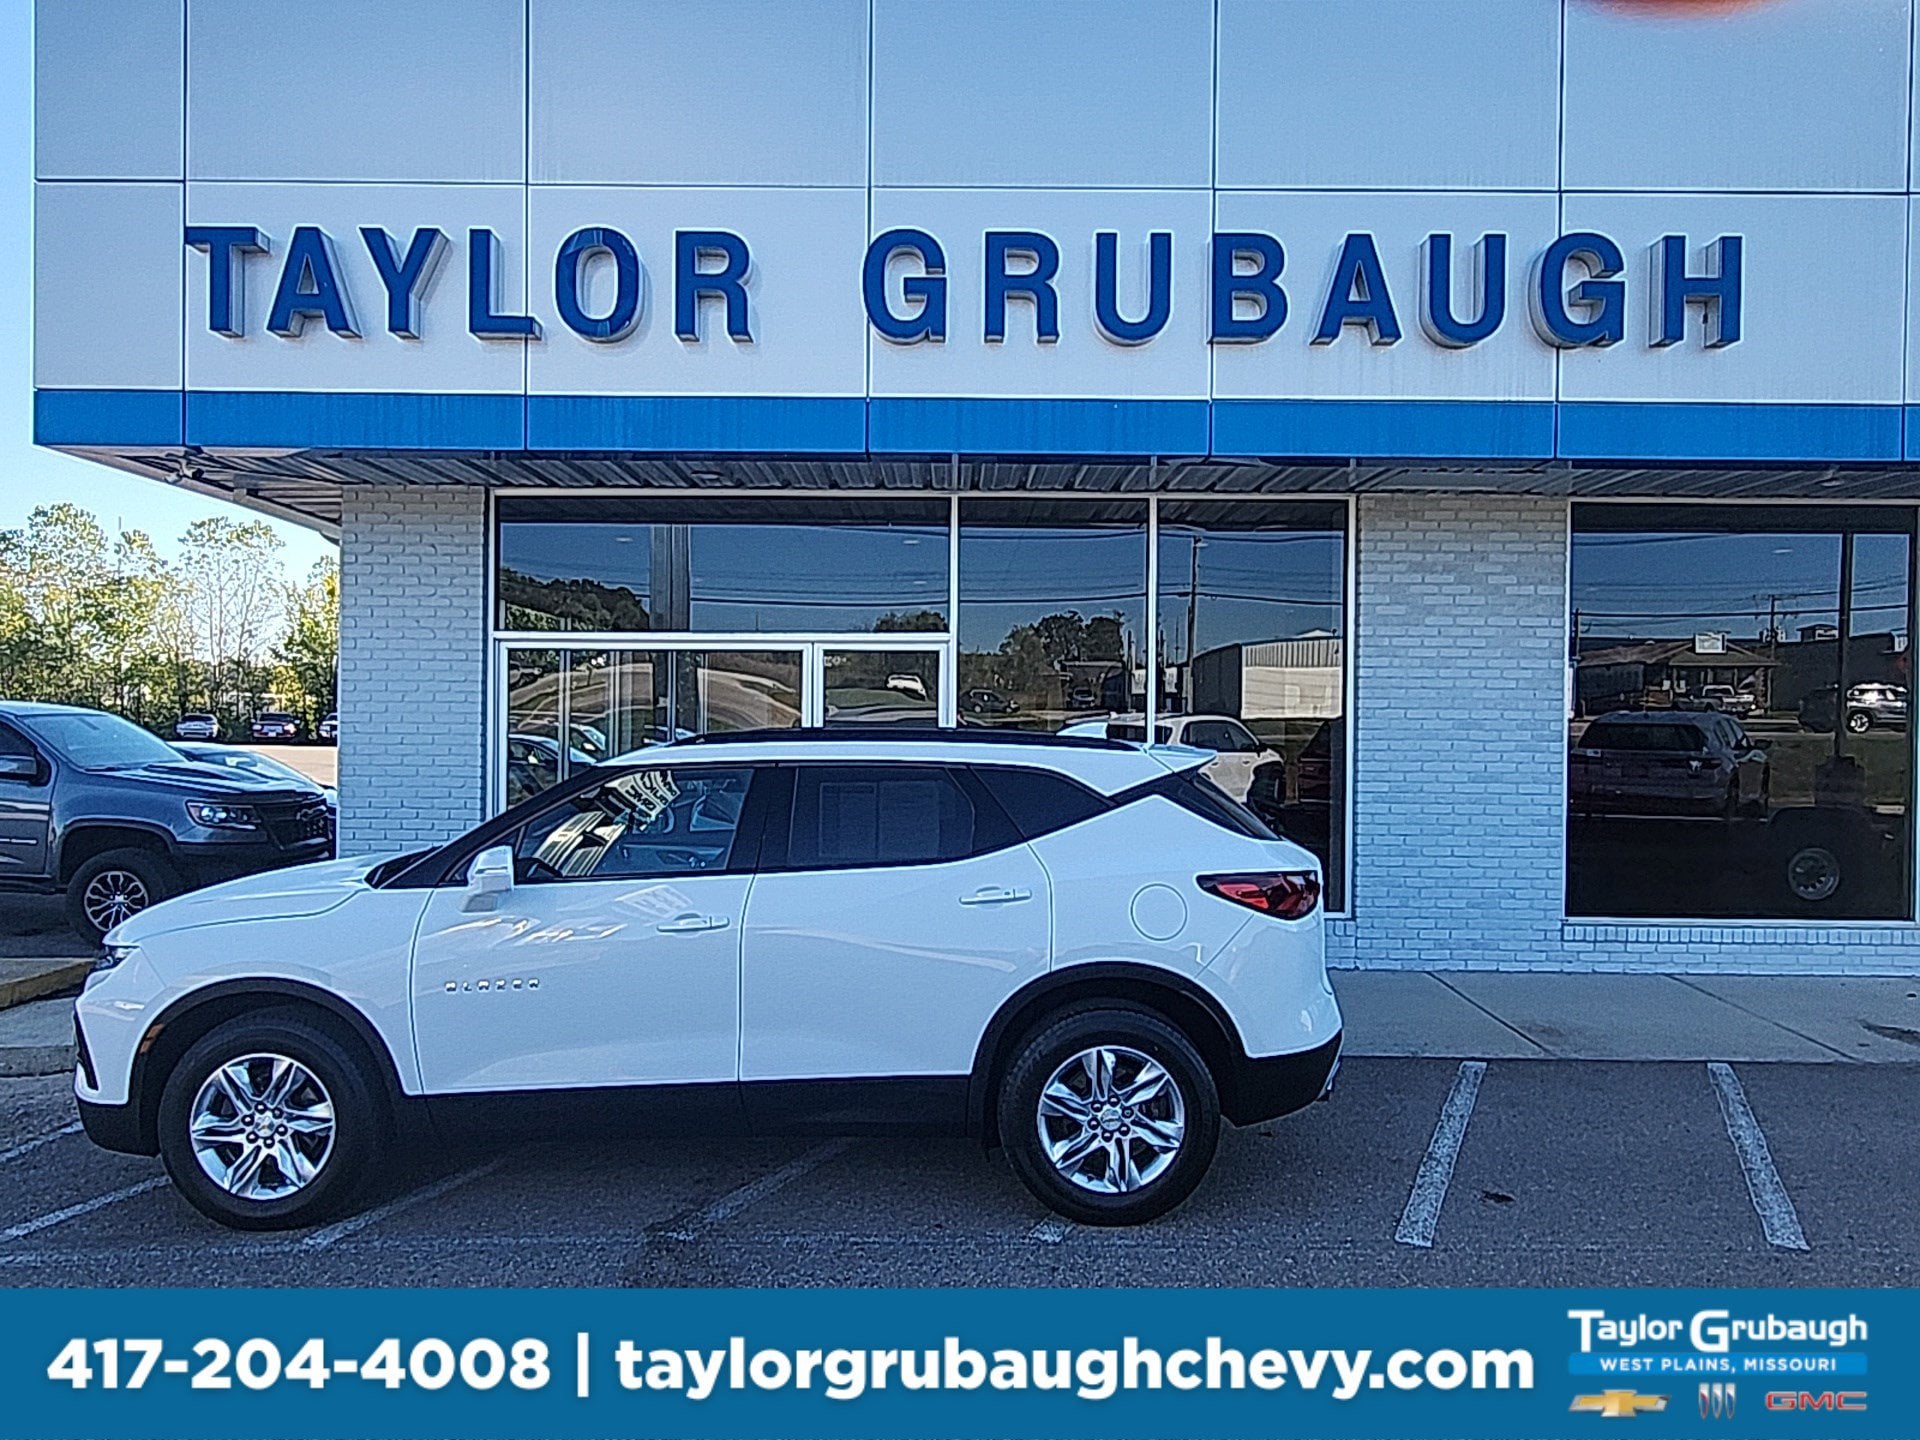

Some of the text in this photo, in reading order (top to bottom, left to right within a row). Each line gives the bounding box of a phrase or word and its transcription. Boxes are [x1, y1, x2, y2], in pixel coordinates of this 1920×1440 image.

[184, 227, 1743, 349] TAYLOR GRUBAUGH
[444, 978, 540, 992] BLAZER
